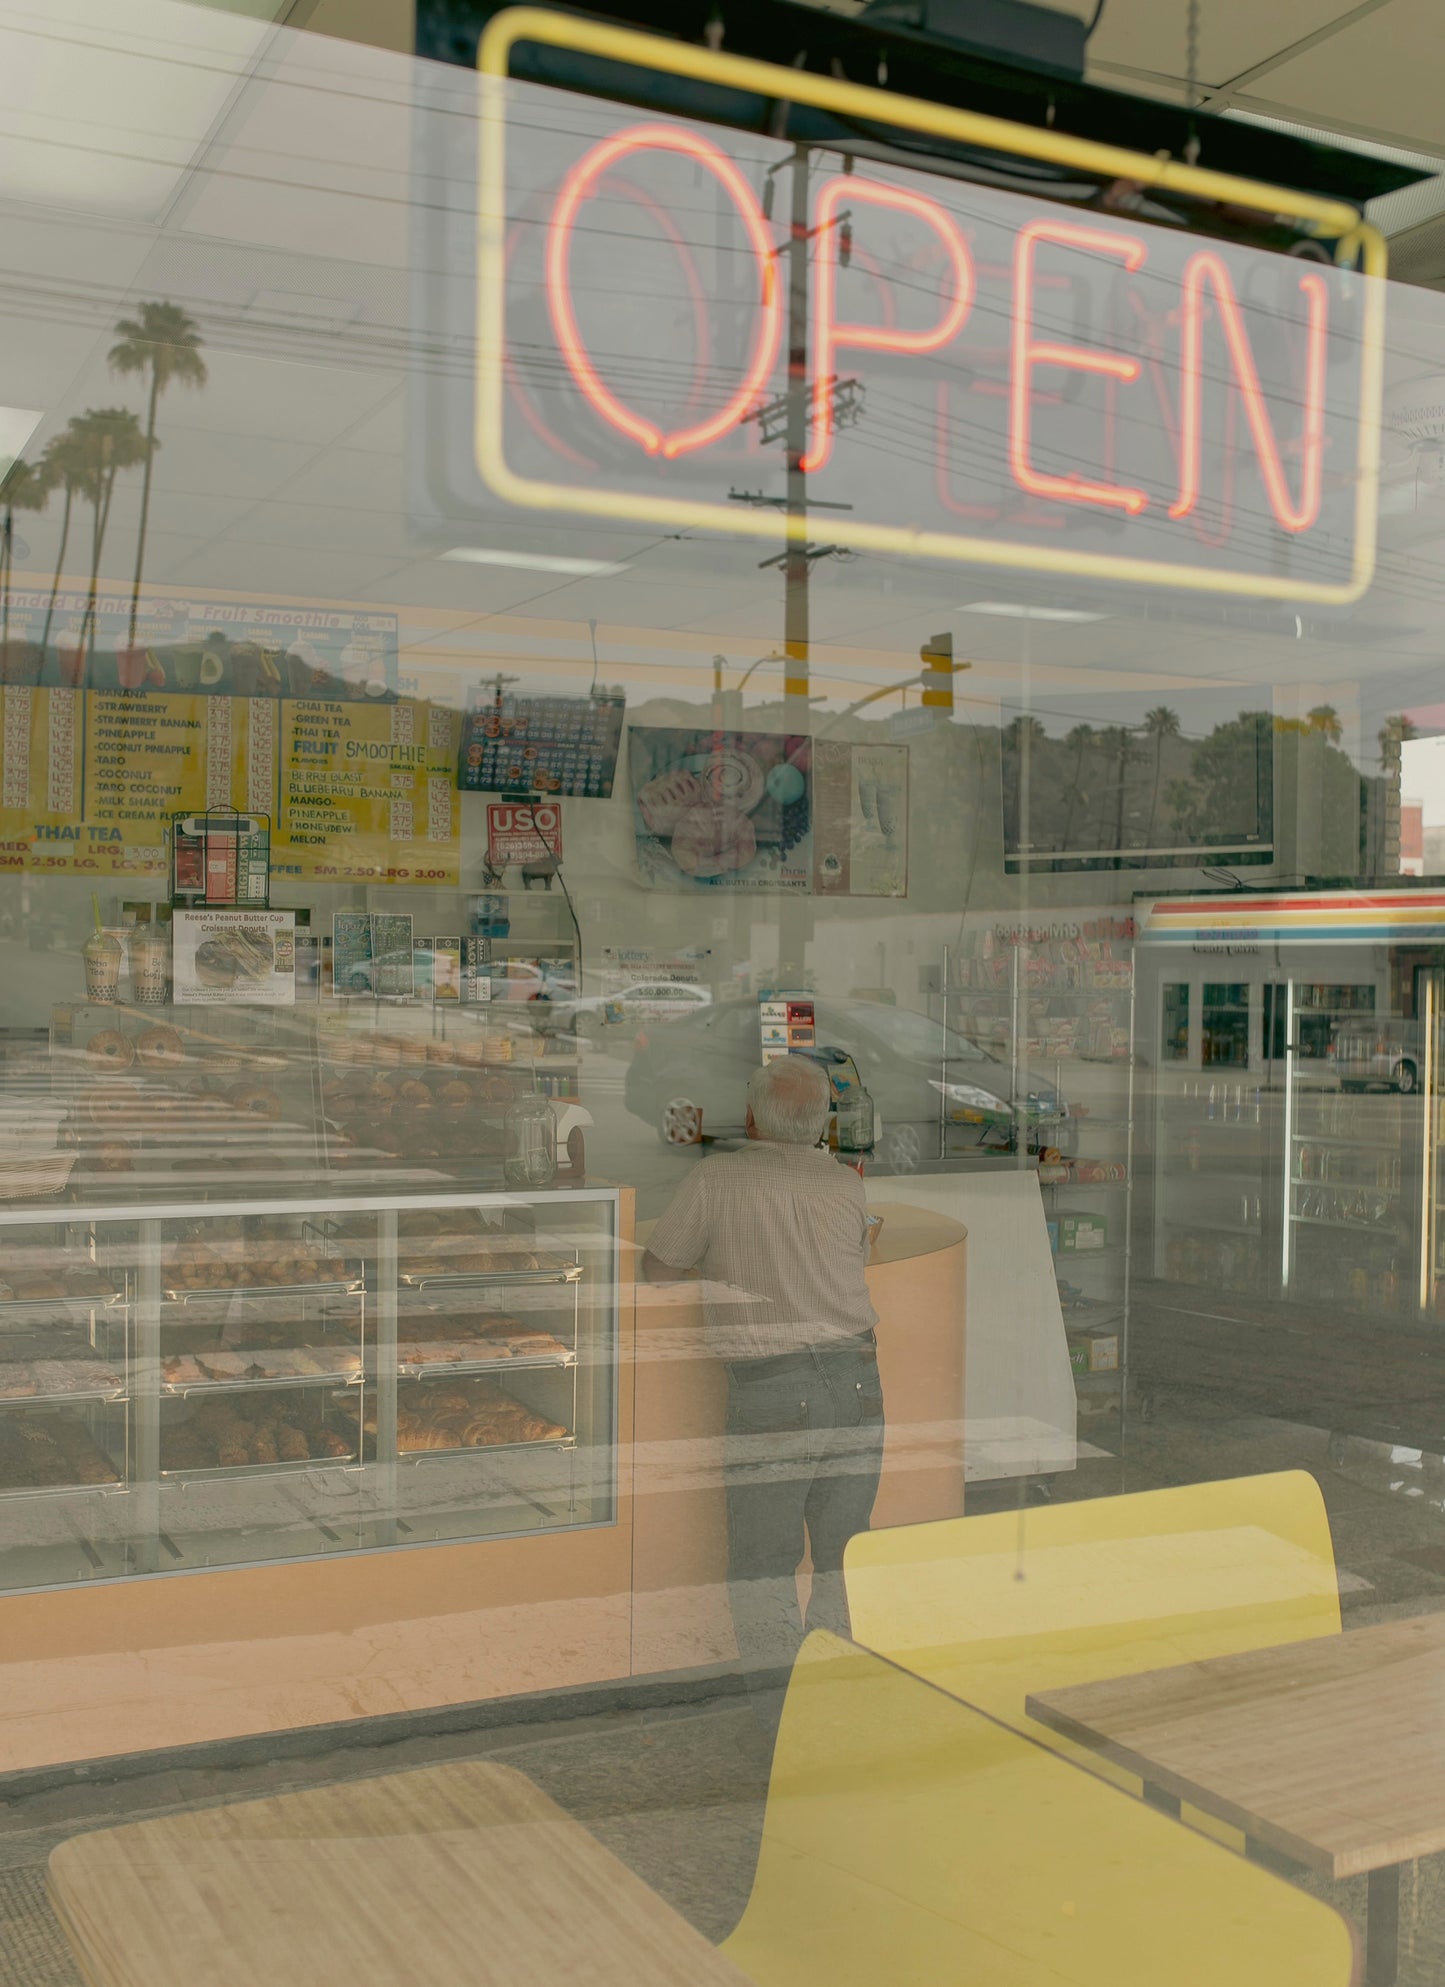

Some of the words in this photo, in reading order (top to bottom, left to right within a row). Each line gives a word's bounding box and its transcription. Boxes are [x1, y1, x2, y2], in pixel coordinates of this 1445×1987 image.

[546, 123, 1329, 532] OPEN
[203, 607, 247, 622] Fruit
[253, 610, 341, 628] Smoothie
[324, 703, 343, 713] TEA
[160, 719, 201, 729] BANANA
[333, 716, 351, 727] TEA
[322, 729, 340, 739] TEA
[145, 745, 192, 756] PINEAPPLE
[293, 741, 339, 756] FRUIT
[346, 740, 426, 764] SMOOTHIE
[291, 770, 326, 781] BERRY
[130, 785, 183, 796] COCONUT
[289, 783, 354, 797] BLUEBERRY
[360, 788, 404, 800] BANANA
[128, 798, 165, 808] SHAKE
[118, 811, 156, 821] CREAM
[290, 809, 348, 821] PINEAPPLE
[493, 808, 558, 832] USO
[34, 825, 81, 841] THAI
[87, 826, 123, 842] TEA
[290, 835, 326, 845] MELON
[0, 858, 24, 867] SM
[31, 858, 67, 867] 2.50
[73, 858, 99, 869] LG.
[111, 860, 137, 870] LG.
[314, 866, 338, 875] SM
[344, 868, 375, 877] 2.50
[379, 868, 409, 878] LRG
[414, 870, 446, 879] 3.00
[185, 913, 213, 921] Reese's
[215, 914, 242, 922] Peanut
[243, 914, 268, 922] Butter
[270, 915, 284, 924] Cup
[201, 924, 237, 933] Croissant
[238, 924, 268, 934] Donuts!
[669, 973, 699, 984] Donuts
